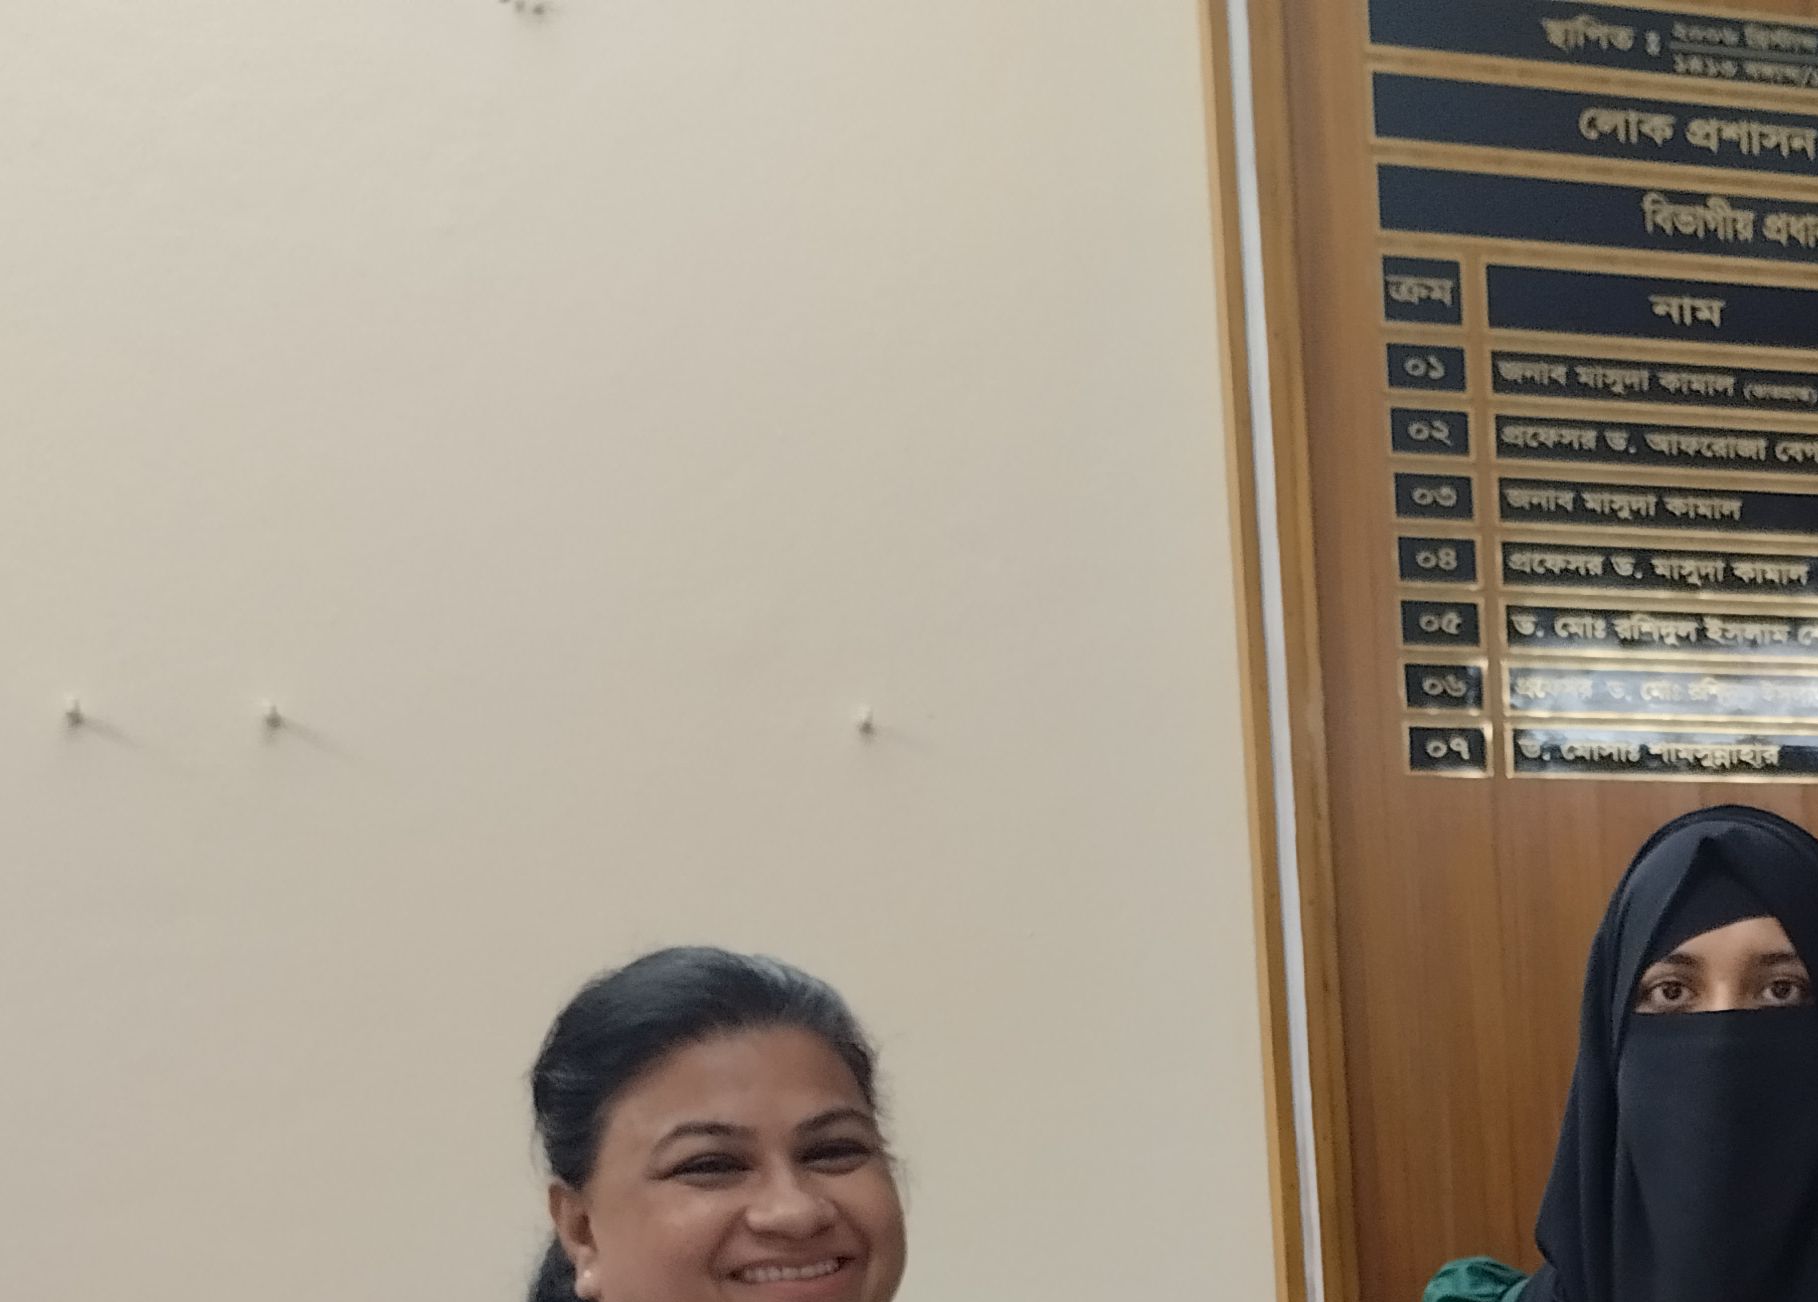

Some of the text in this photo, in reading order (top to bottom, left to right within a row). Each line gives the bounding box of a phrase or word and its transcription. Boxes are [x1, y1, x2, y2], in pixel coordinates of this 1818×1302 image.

[1542, 14, 1636, 52] স্থাপিত
[1579, 107, 1676, 147] লোক
[1685, 117, 1818, 162] প্রশাসন
[1642, 191, 1754, 243] বিভাগীয়
[1388, 274, 1454, 307] ক্রম
[1649, 293, 1725, 329] নাম
[1404, 355, 1445, 381] ০১
[1499, 360, 1568, 387] জনাব
[1574, 364, 1650, 398] মাসুদা
[1658, 371, 1735, 398] কামাল
[1408, 420, 1452, 448] ০২
[1500, 424, 1598, 453] প্রফেসর
[1605, 430, 1636, 455] ড.
[1412, 484, 1458, 508] ০৩
[1505, 487, 1743, 522] জনাব মাসুদা কামাল
[1415, 547, 1458, 572] ০৪
[1507, 550, 1810, 588] প্রফেসর ড. মাসুদা কামাল
[1418, 610, 1465, 637] ০৫
[1511, 613, 1544, 639] ড.
[1703, 616, 1790, 647] ইসলাম
[1422, 675, 1467, 699] ০৬
[1426, 737, 1470, 762] ০৭
[1519, 736, 1551, 763] ড.
